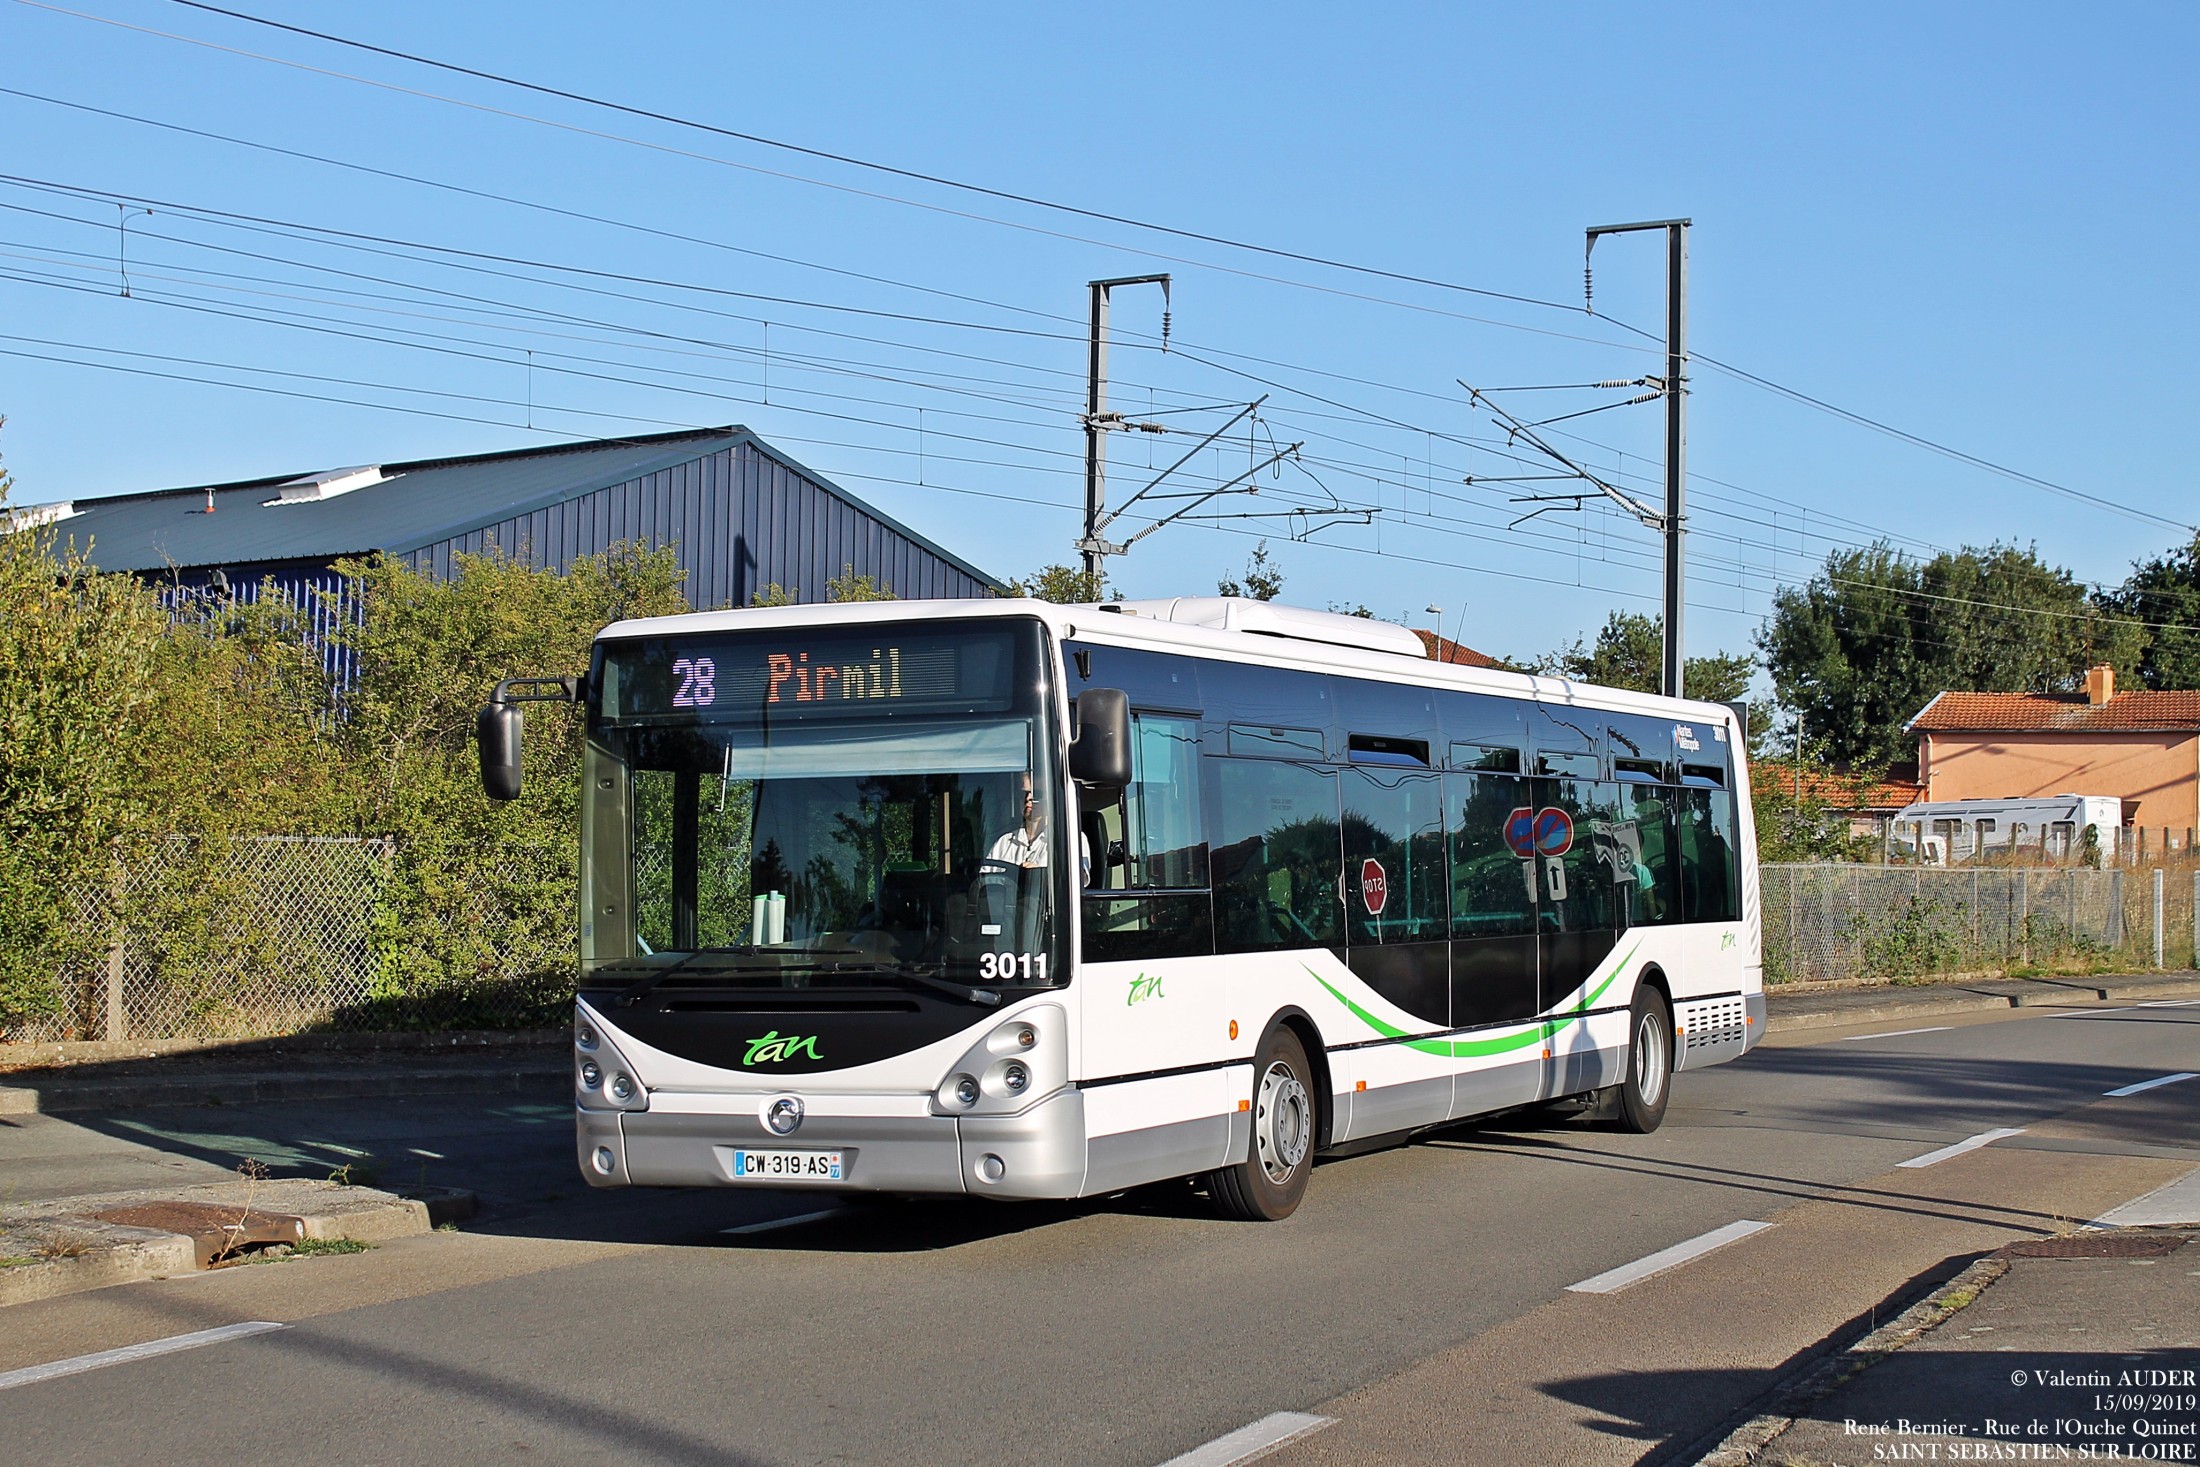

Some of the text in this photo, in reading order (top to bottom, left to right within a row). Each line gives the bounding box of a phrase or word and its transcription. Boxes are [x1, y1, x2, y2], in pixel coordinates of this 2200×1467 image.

[673, 648, 901, 706] 28 Pirmil
[980, 952, 1047, 979] 3011
[1128, 972, 1165, 1006] tan
[743, 1031, 824, 1065] tan
[745, 1155, 829, 1174] CW-319-AS
[831, 1167, 839, 1176] 77
